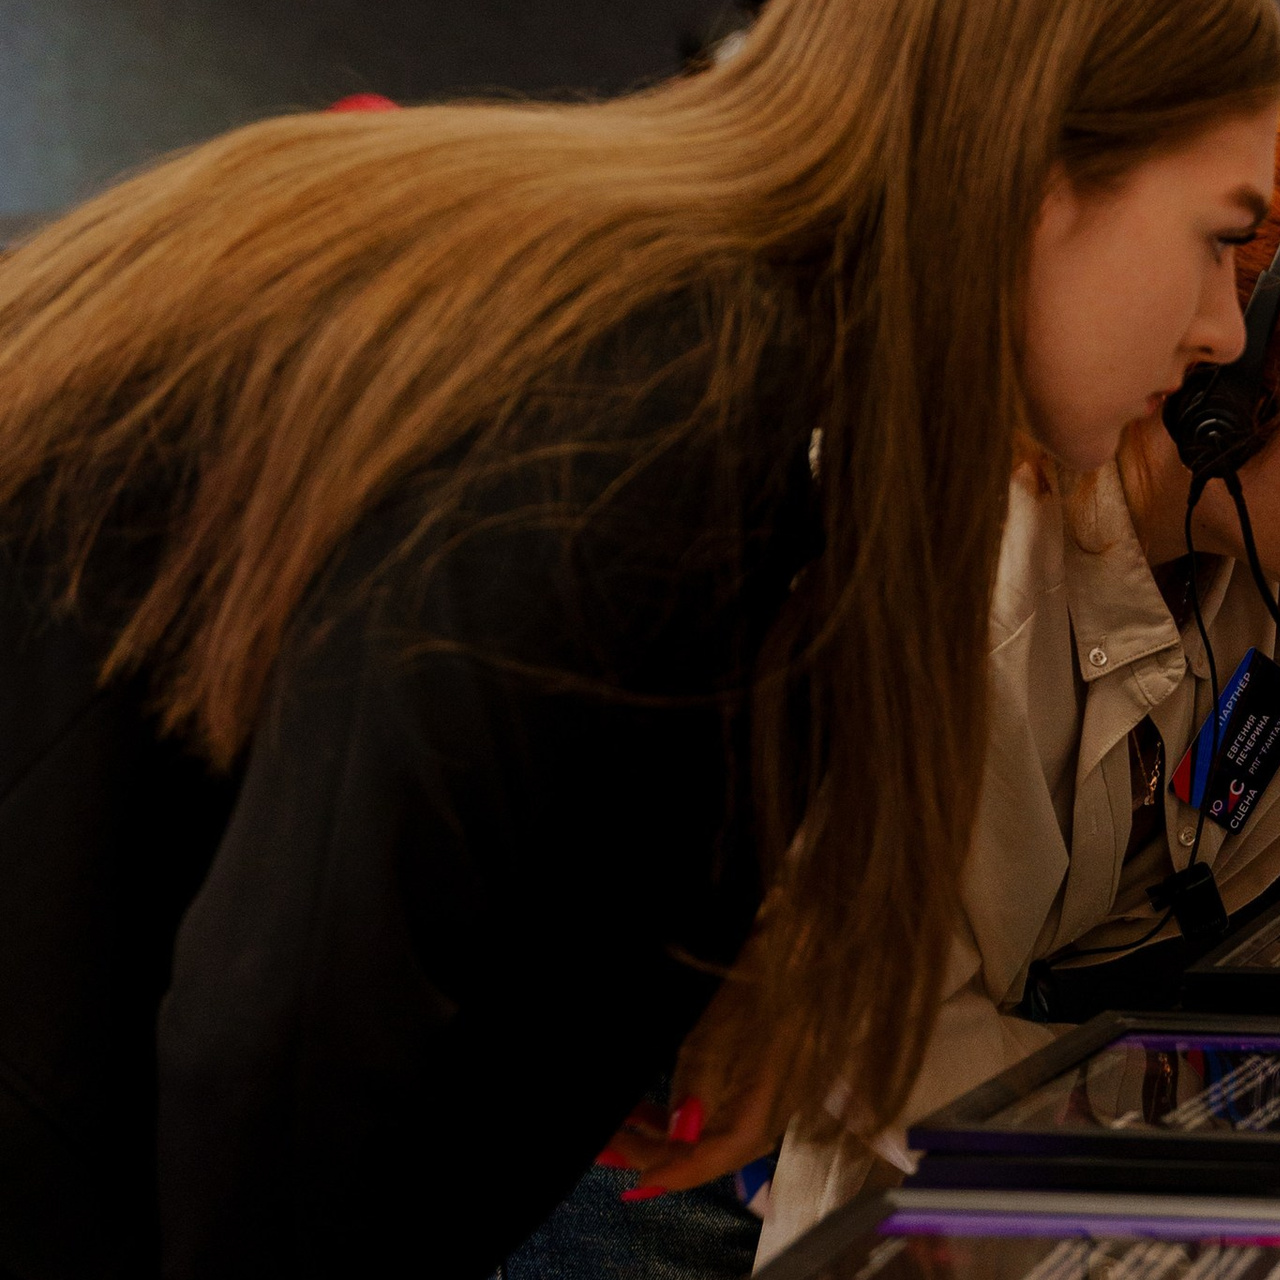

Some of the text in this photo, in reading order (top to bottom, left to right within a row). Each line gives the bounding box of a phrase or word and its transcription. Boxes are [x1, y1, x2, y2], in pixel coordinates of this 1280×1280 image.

[1226, 714, 1257, 760] ЕВГЕНИЯ
[1235, 715, 1271, 766] ПЕЧЕРИНА
[1248, 756, 1262, 775] РПГ
[1230, 789, 1258, 829] СЦЕНА
